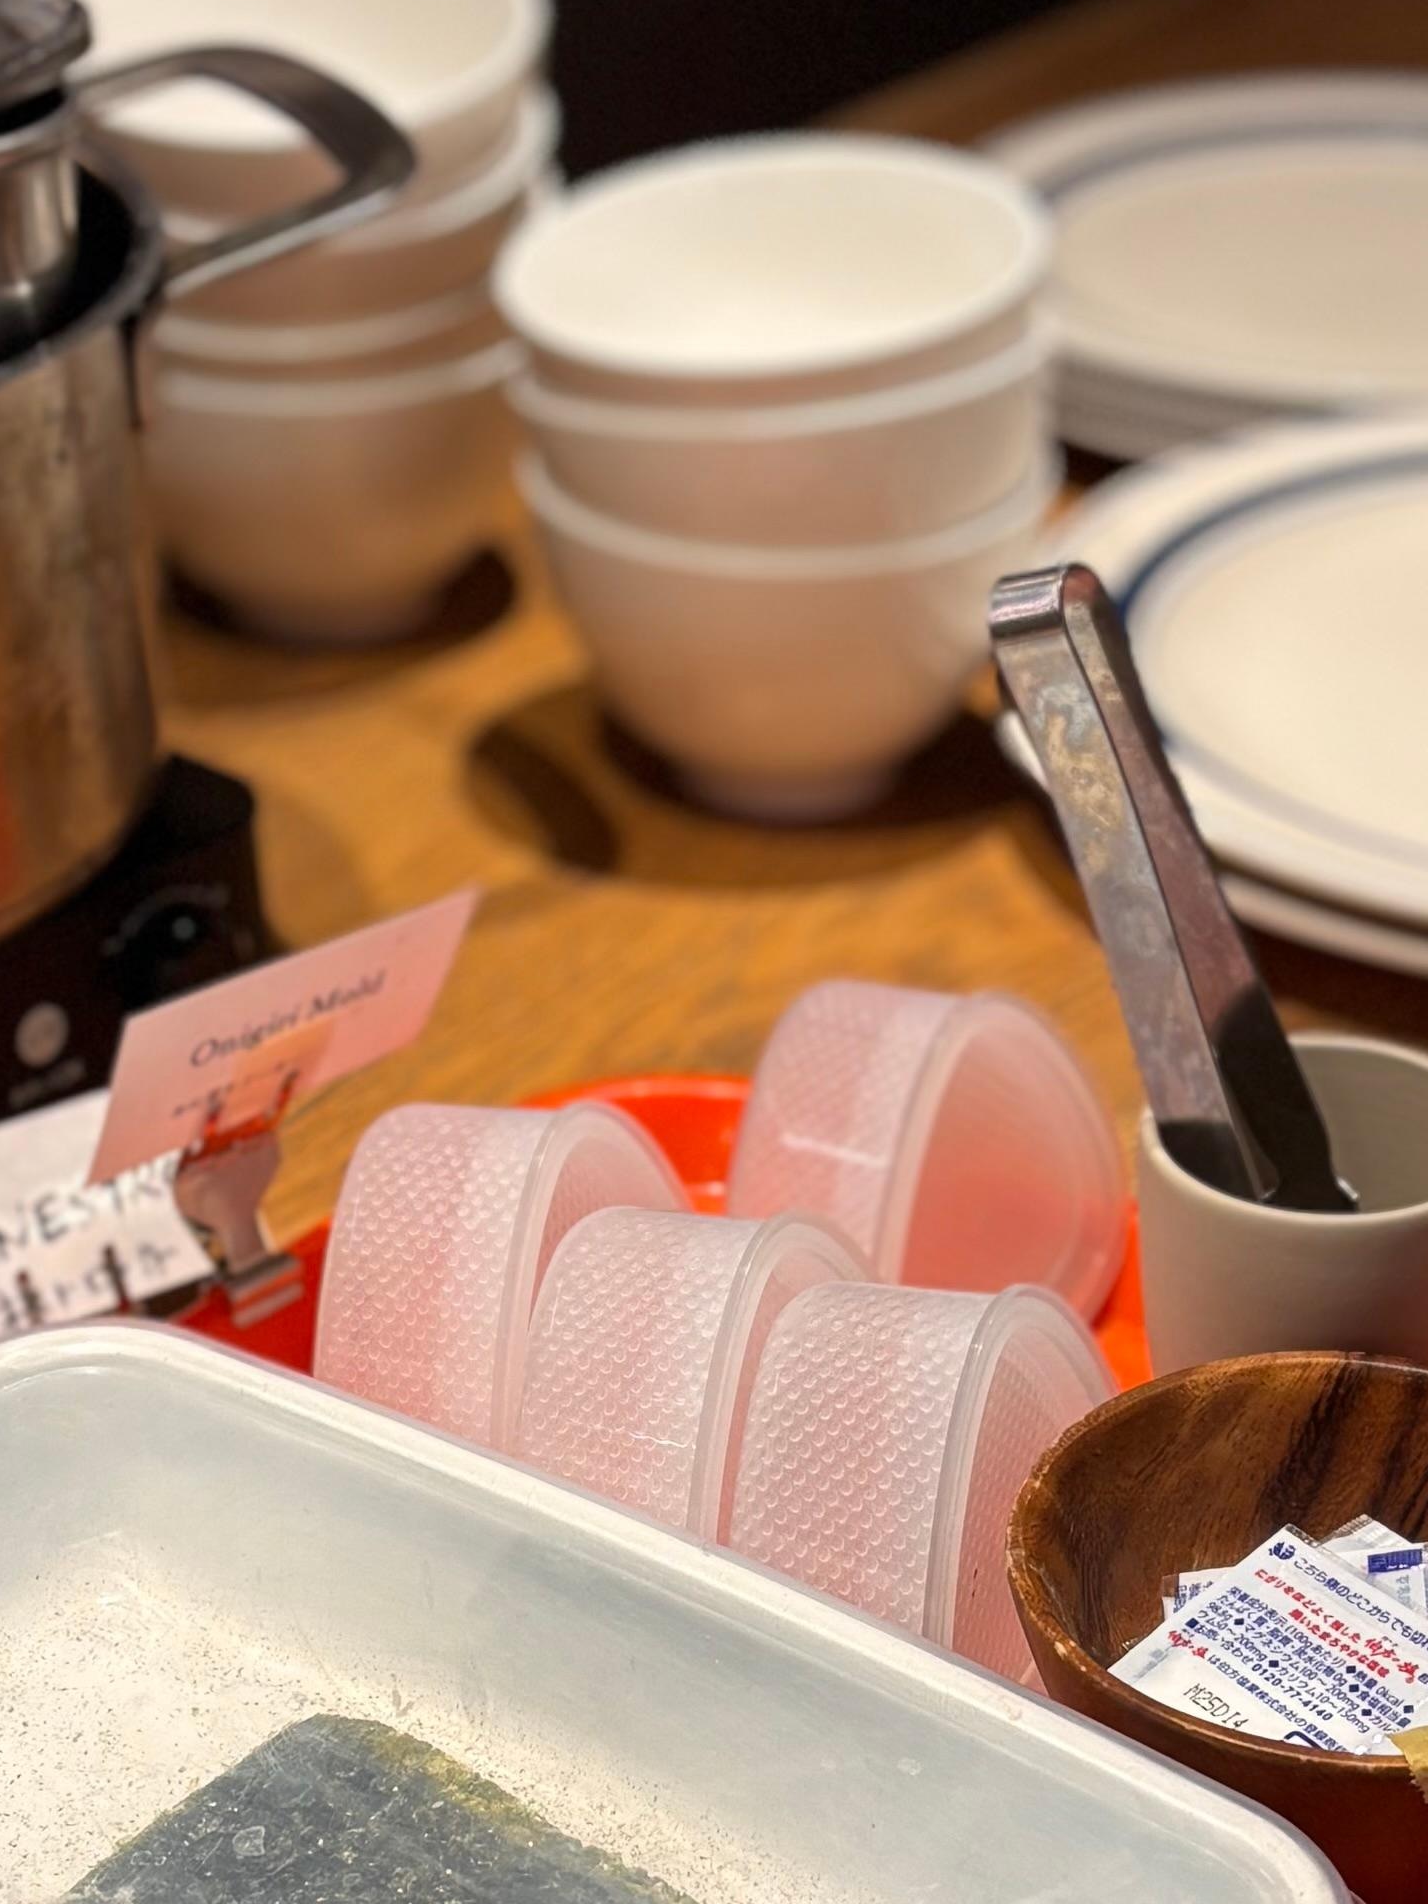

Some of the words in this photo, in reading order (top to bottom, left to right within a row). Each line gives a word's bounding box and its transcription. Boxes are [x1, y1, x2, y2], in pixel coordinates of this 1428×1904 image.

[190, 1001, 302, 1068] Onigiri
[1251, 1662, 1334, 1722] 0120-77-4140
[1375, 1686, 1404, 1708] 0kcal
